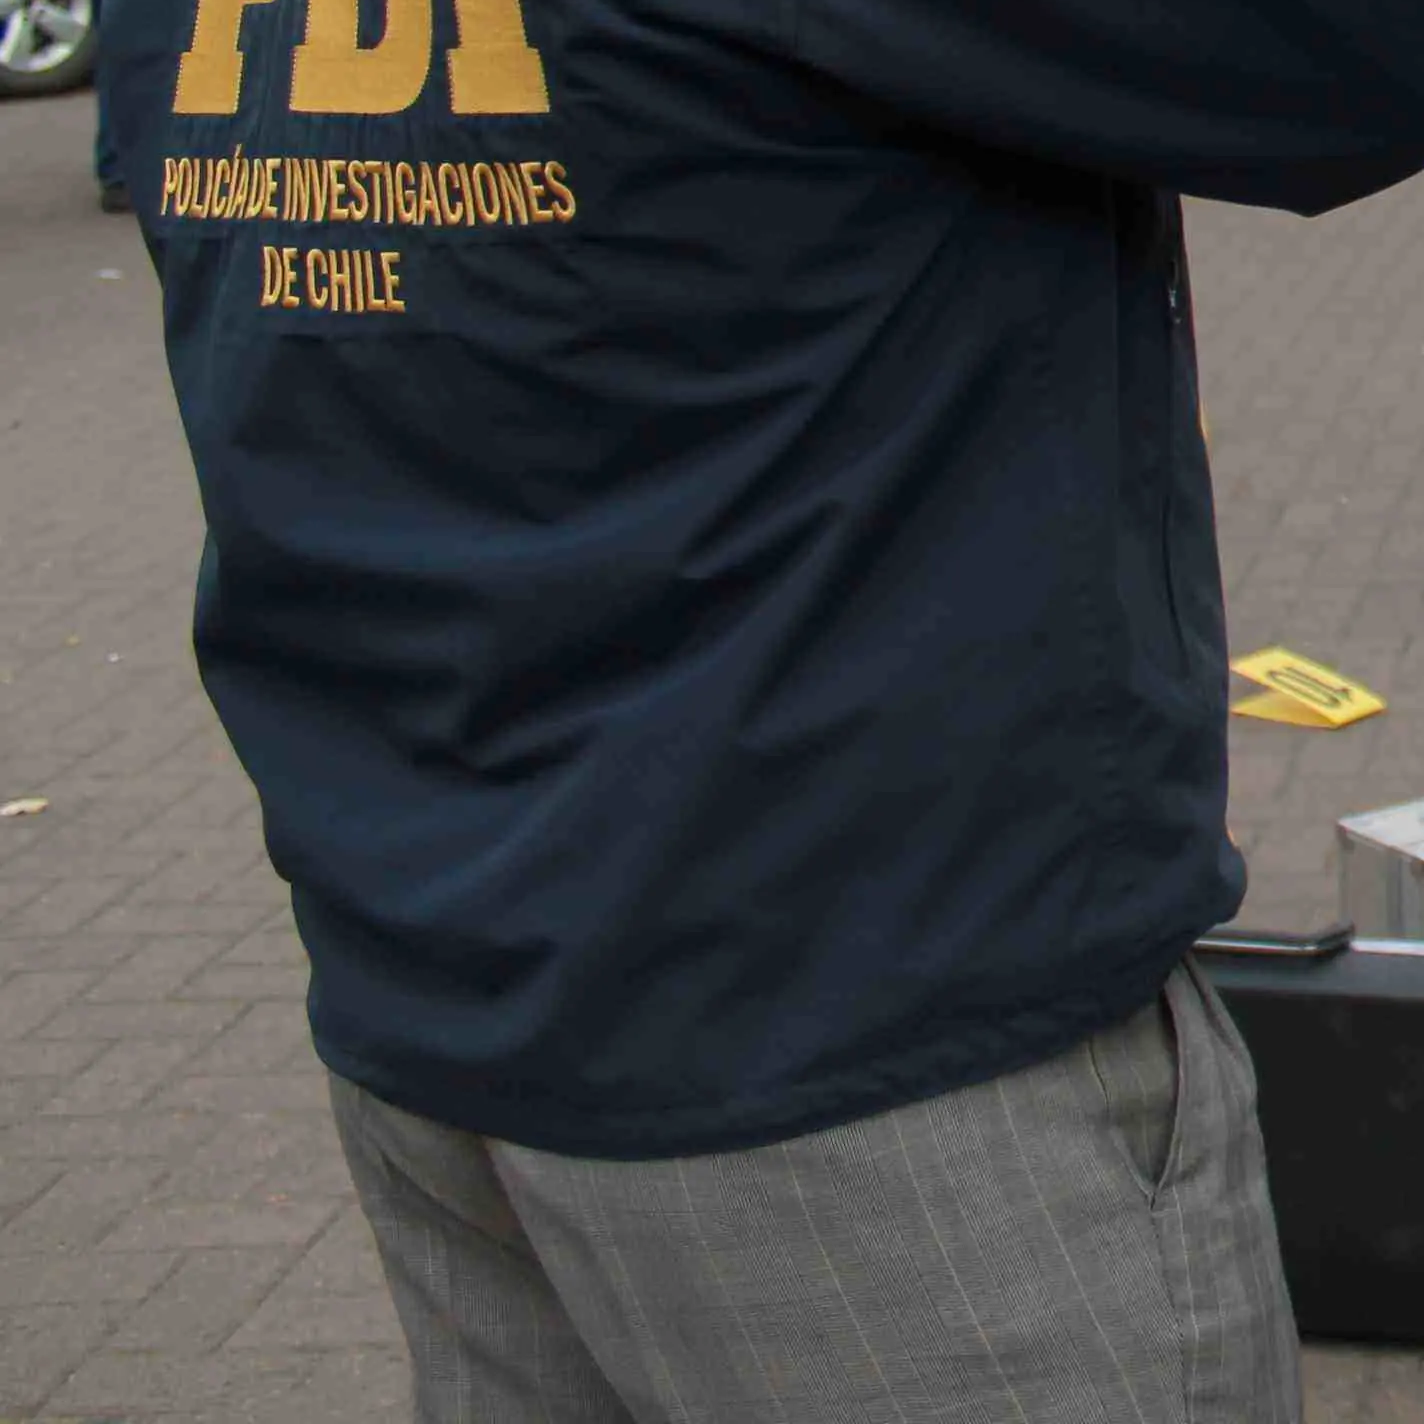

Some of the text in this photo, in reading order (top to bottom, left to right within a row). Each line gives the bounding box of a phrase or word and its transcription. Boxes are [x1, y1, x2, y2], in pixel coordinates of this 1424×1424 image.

[160, 143, 577, 227] POLICÍA DE INVESTIGACIONES
[260, 245, 406, 314] DE CHILE
